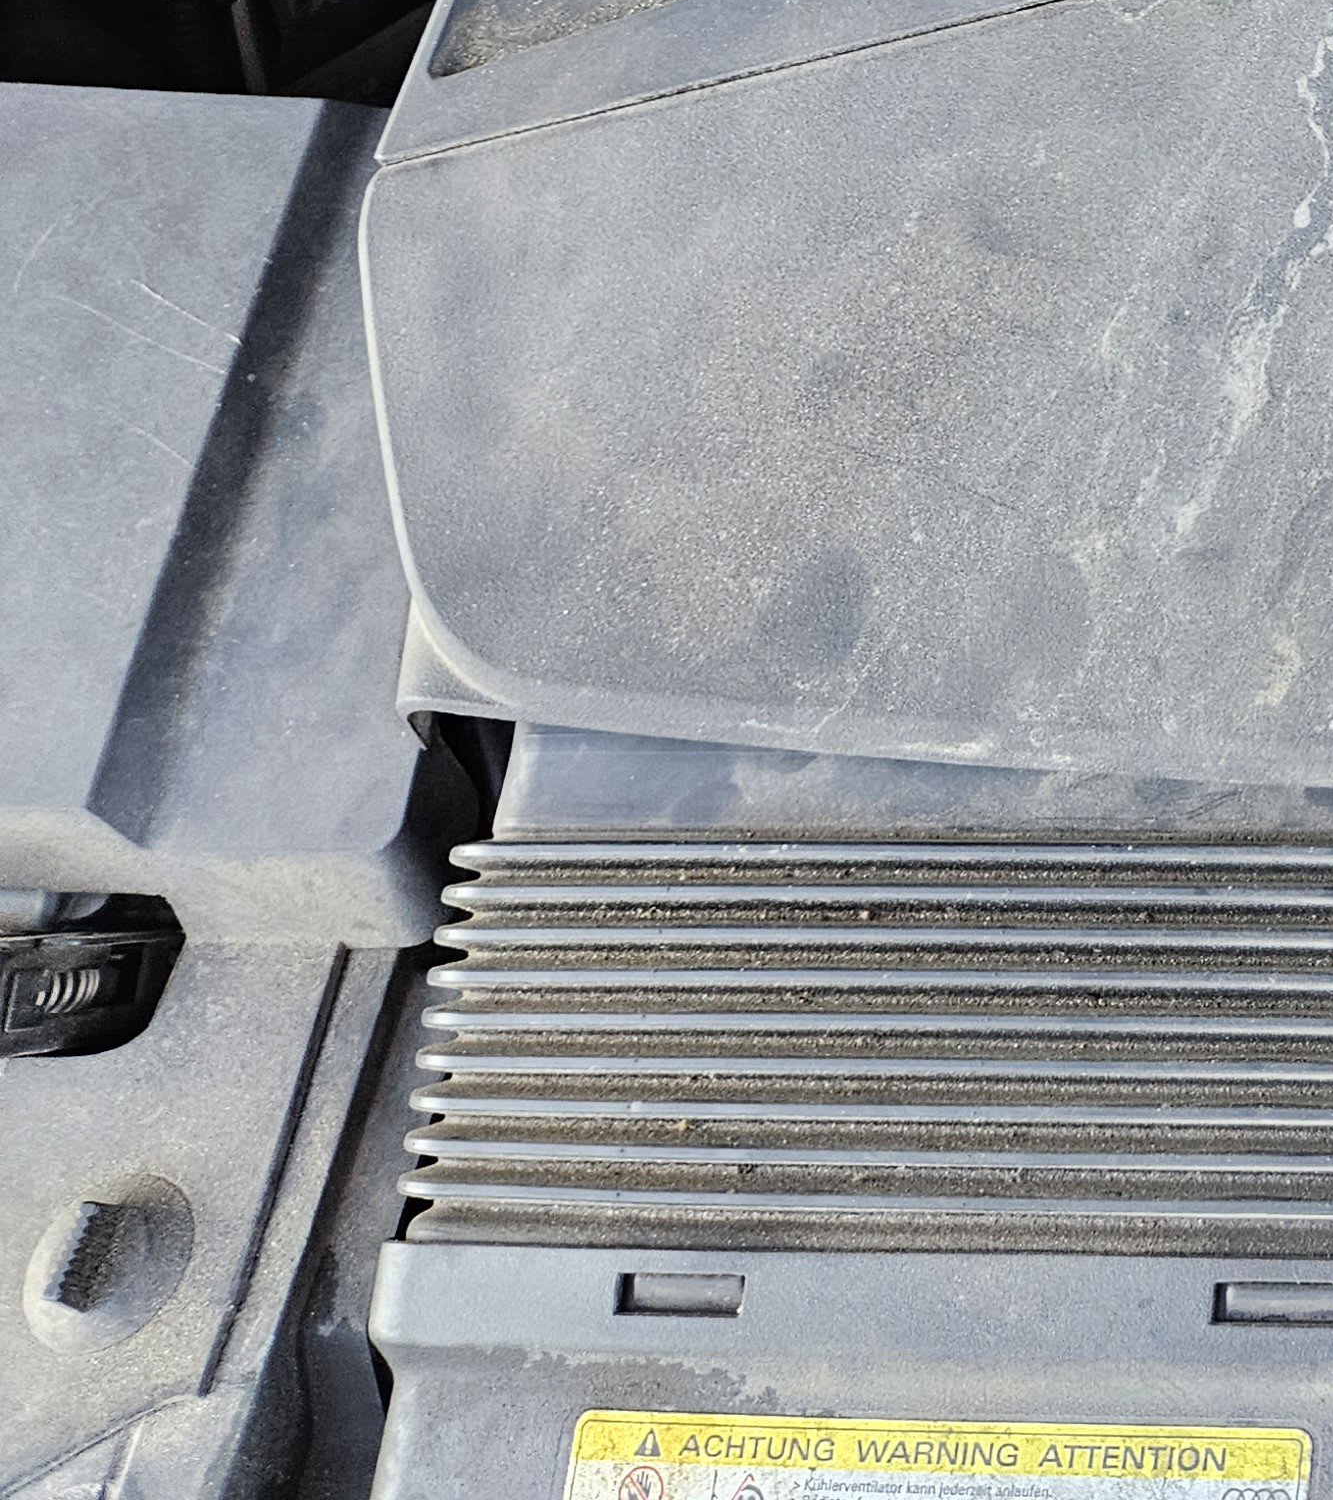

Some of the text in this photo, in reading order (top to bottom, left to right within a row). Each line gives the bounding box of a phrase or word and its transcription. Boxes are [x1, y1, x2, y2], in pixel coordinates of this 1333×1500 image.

[678, 1433, 1228, 1472] ACHTUNG WARNING ATTENTION
[906, 1481, 936, 1495] kann
